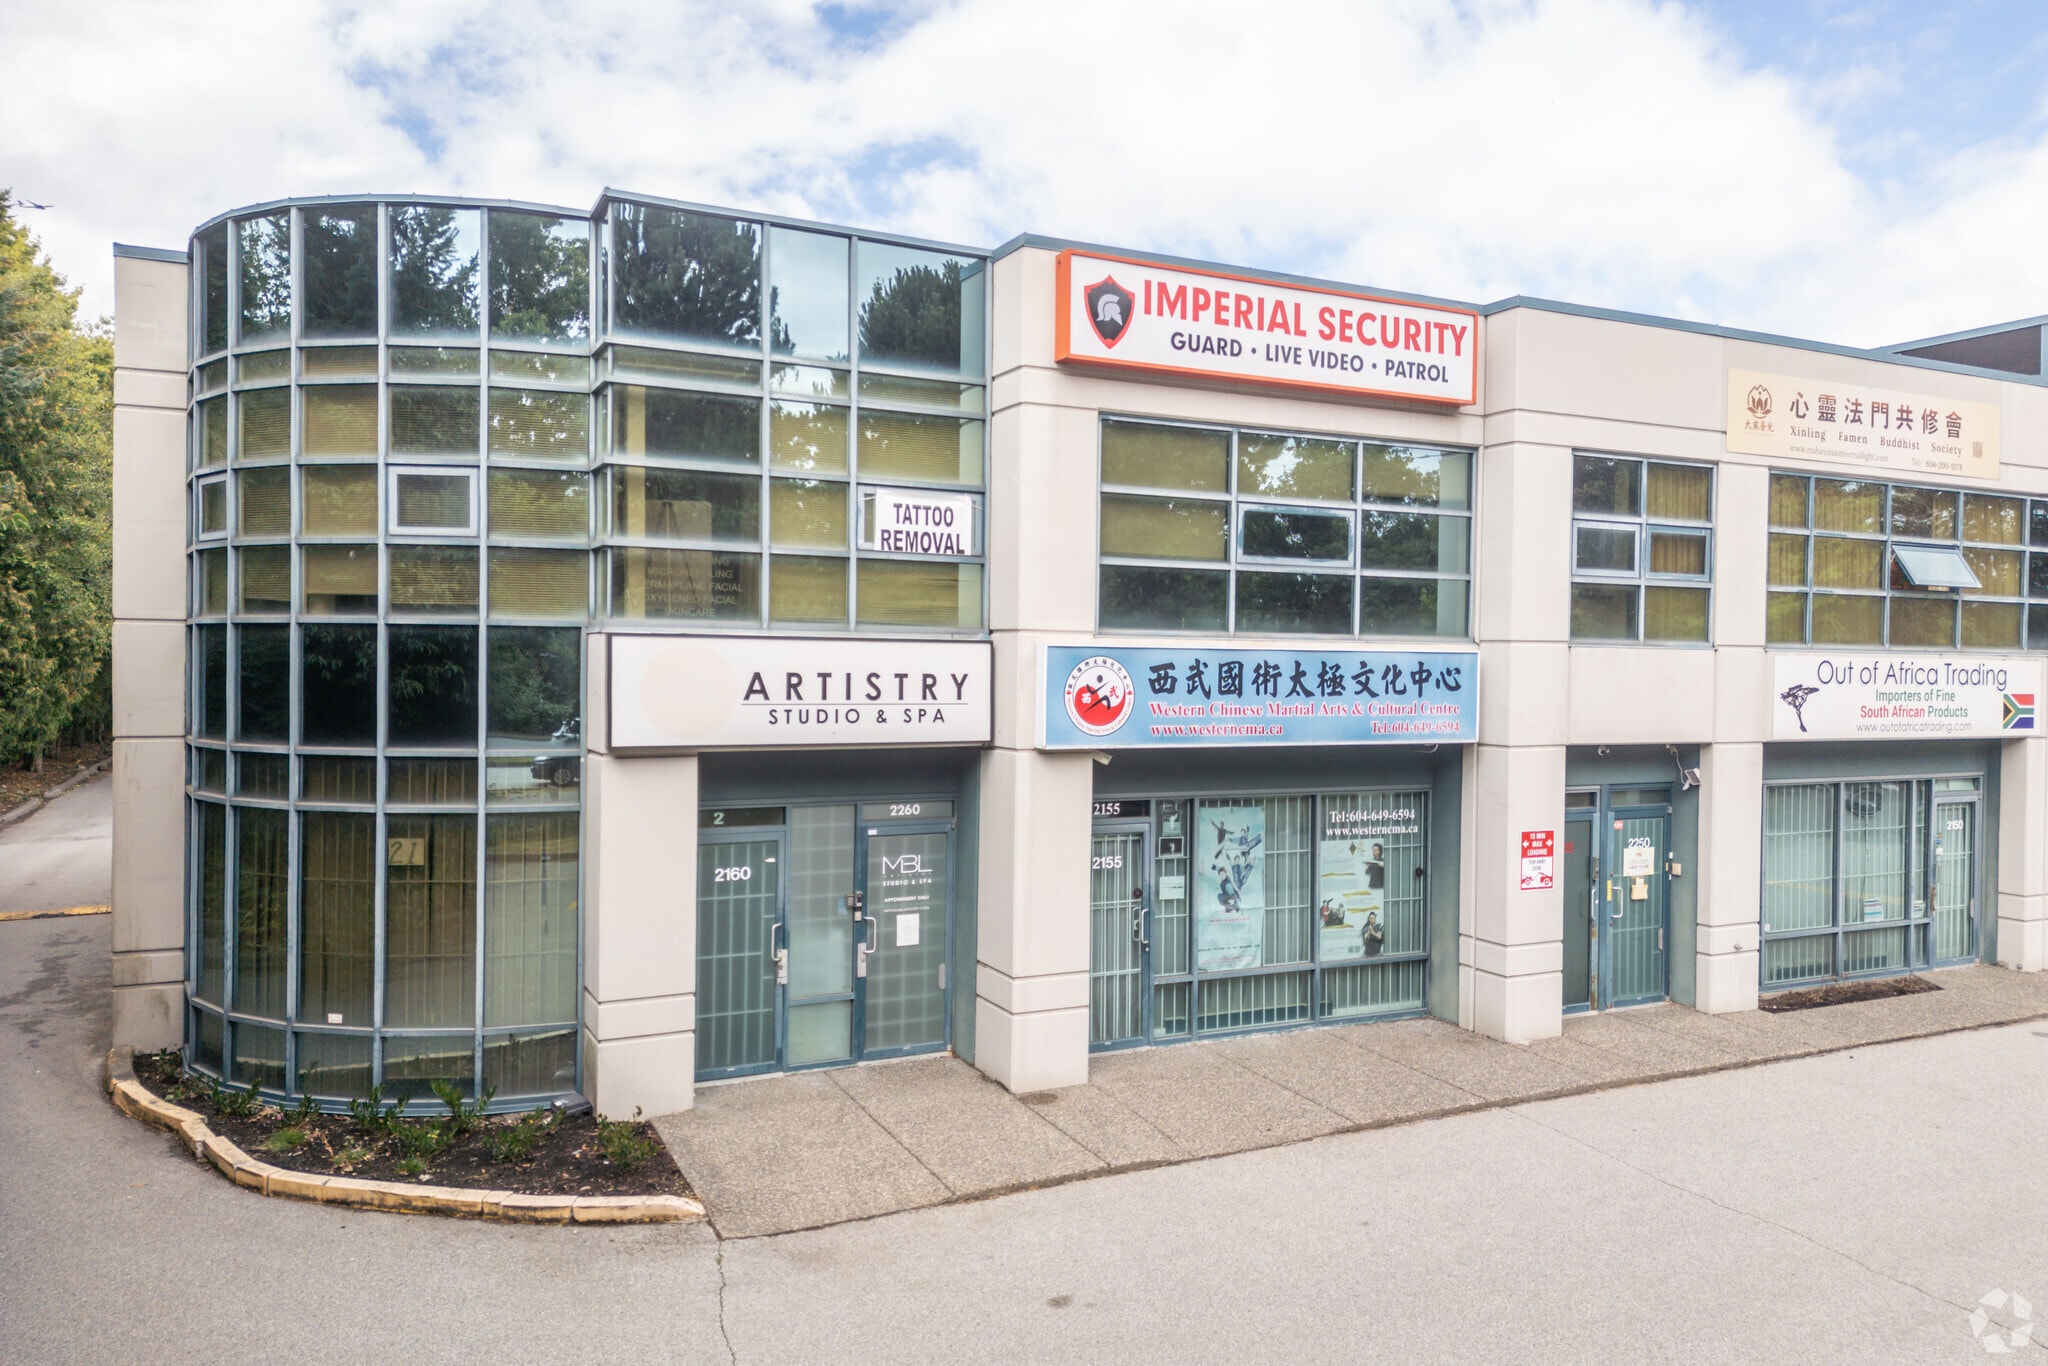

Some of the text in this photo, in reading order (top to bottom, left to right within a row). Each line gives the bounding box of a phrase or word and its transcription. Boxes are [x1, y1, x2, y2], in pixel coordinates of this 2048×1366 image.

[1143, 279, 1468, 358] IMPERIAL SECURITY
[1170, 331, 1449, 384] GUARD LIVE VIDEO PATROL
[1789, 391, 1963, 439] 心靈法門共修會
[1789, 425, 1963, 458] Xinling Famen Buddhist Society
[893, 503, 954, 527] TATTOO
[880, 529, 965, 555] REMOVAL
[664, 607, 716, 617] SKINCARE
[1147, 657, 1462, 700] 西武國術太極文化中心
[1817, 660, 2008, 692] Out of Africa Trading
[742, 671, 969, 701] ARTISTRY
[1875, 689, 1956, 704] Importers of Fine
[768, 708, 946, 725] STUDIO & SPA
[1149, 701, 1206, 718] Western
[1208, 701, 1264, 718] Chinese
[1265, 700, 1316, 717] Martial
[1319, 700, 1348, 717] Arts
[1352, 701, 1364, 716] &
[1367, 700, 1418, 717] Cultural
[1419, 700, 1460, 716] Centre
[1860, 705, 1969, 718] South African Products
[1150, 722, 1284, 738] www.westerncma.ca
[1370, 720, 1461, 736] Tel:604-649-6594
[1856, 721, 1972, 734] www.outofafricatrading.com
[889, 804, 921, 817] 2260
[1093, 803, 1121, 816] 2155
[1329, 808, 1416, 823] Tel:604-649-6594
[713, 812, 725, 825] 2
[1946, 819, 1964, 831] 2150
[1326, 825, 1418, 836] www.westerncma.ca
[1628, 837, 1651, 848] 2250
[882, 854, 933, 875] MBL
[1092, 855, 1122, 870] 2155
[714, 866, 751, 882] 2160
